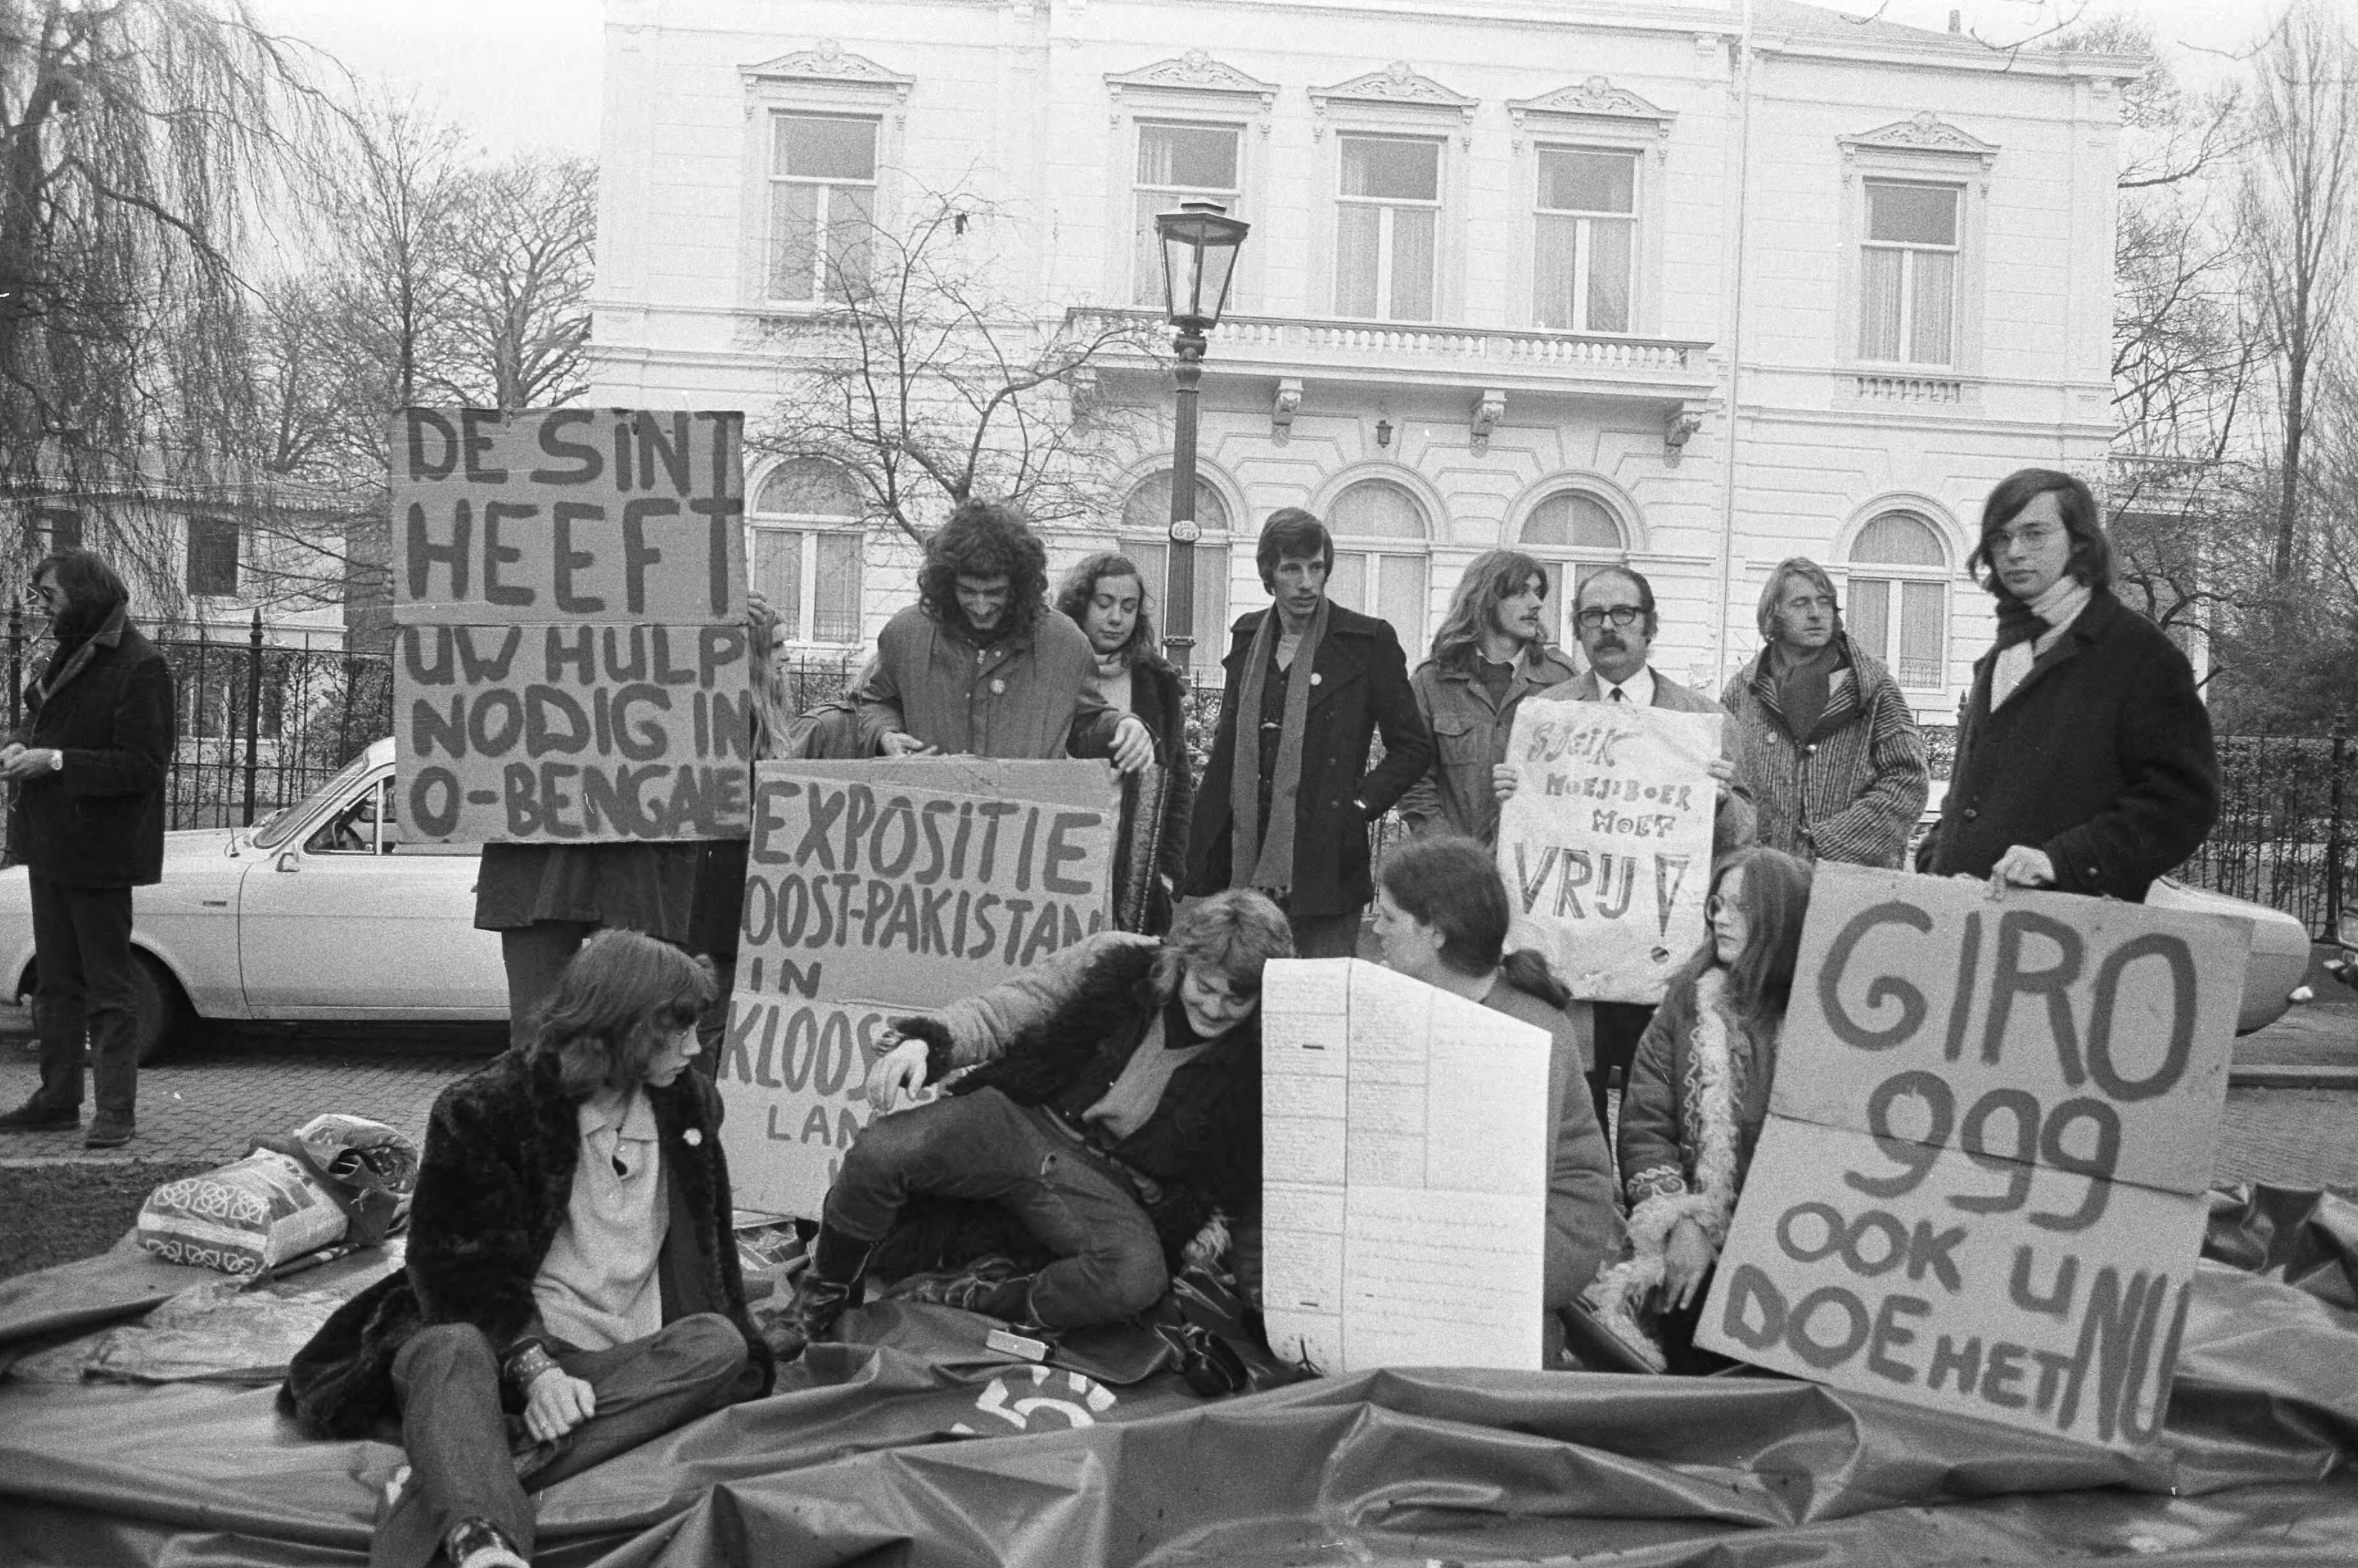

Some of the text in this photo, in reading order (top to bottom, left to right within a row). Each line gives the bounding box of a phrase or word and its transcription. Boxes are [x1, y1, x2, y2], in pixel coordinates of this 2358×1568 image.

[407, 409, 744, 496] DE SINT
[407, 498, 744, 615] HEEFT
[404, 625, 747, 689] UW HULP
[412, 683, 750, 761] NODIG IN
[752, 780, 1103, 895] EXPOSITIE
[1592, 809, 1676, 838] MOET
[742, 872, 1102, 966] OOST-PAKISTAN
[750, 957, 822, 998] IN
[1818, 901, 2197, 1102] GIRO
[717, 1001, 929, 1100] KLOOS
[768, 1105, 877, 1149] LAN
[1843, 1070, 2121, 1232] 999
[1776, 1201, 2079, 1321] OOK U
[1723, 1264, 2189, 1445] DOE HET NU
